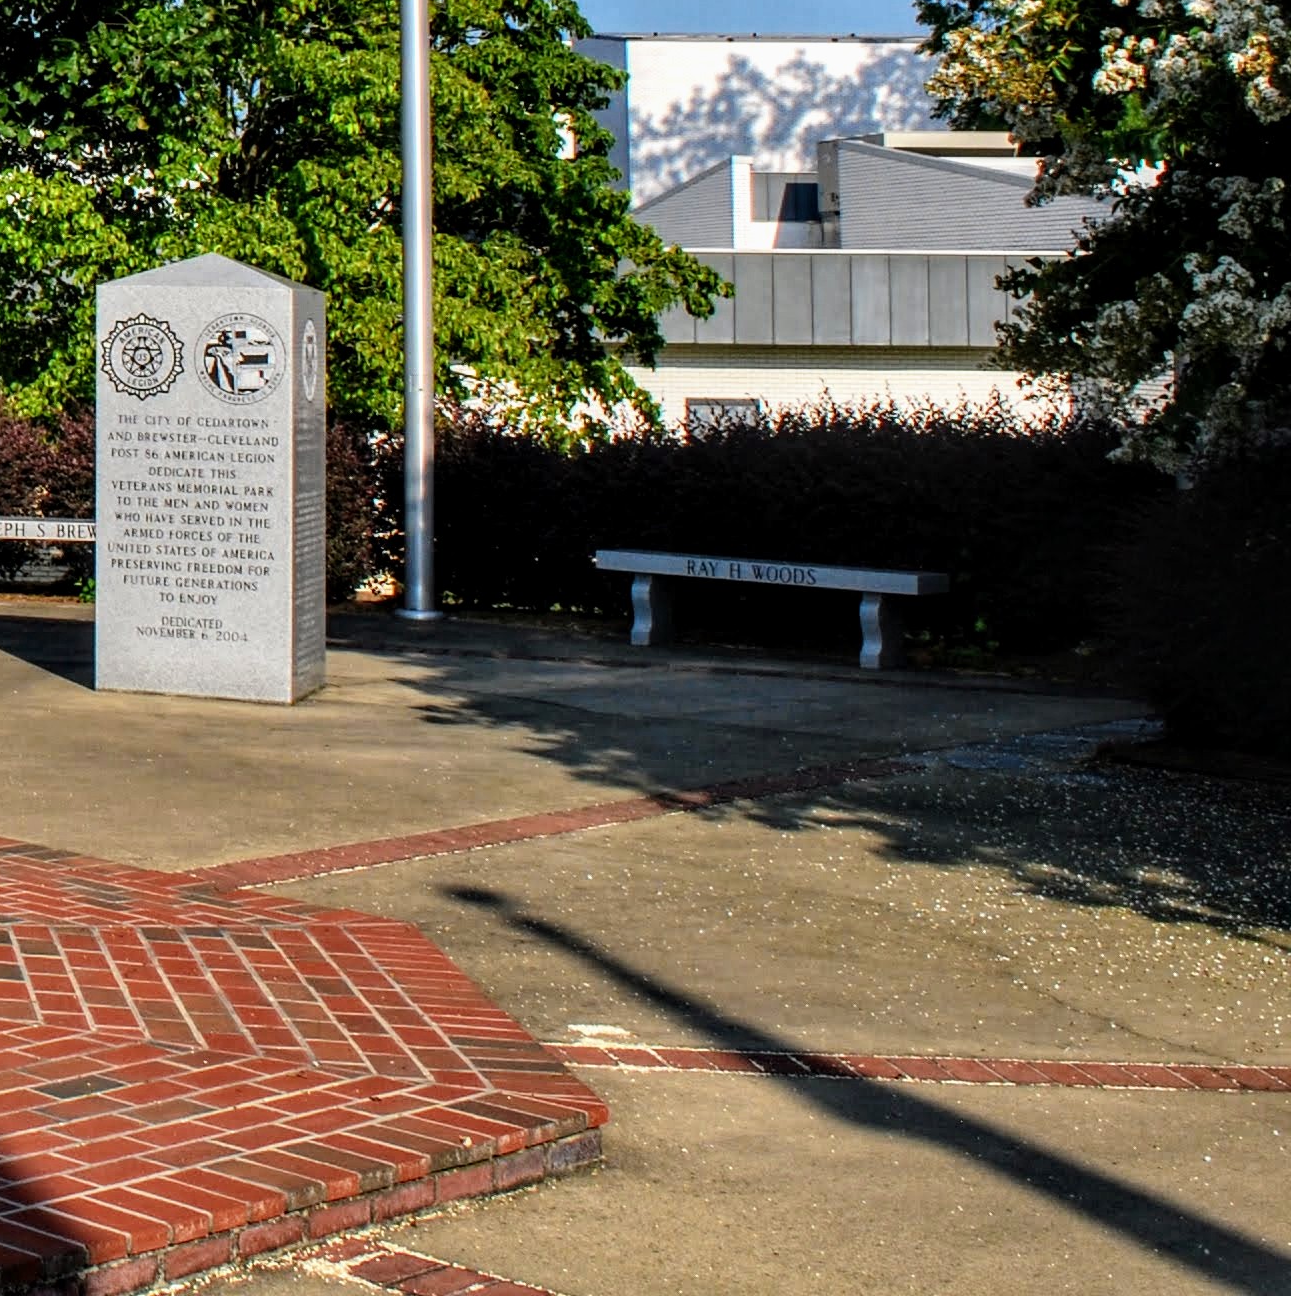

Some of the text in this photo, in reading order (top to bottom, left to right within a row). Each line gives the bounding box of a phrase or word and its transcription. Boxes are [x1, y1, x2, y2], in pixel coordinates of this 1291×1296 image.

[119, 327, 165, 343] AMERICAN
[127, 377, 159, 386] LEGION
[119, 415, 269, 429] THE CITY OF CEDARTOWN
[108, 432, 132, 441] AND
[111, 448, 138, 457] POST
[164, 451, 224, 461] AMERICAN
[231, 453, 275, 463] LEGION
[149, 467, 236, 479] DEDICATE THIS
[111, 481, 274, 496] VETERANS MEMORIAL PARK
[117, 497, 268, 512] TO THE MEN AND WOMEN
[115, 512, 270, 528] WHO HAVE SERVED IN THE
[37, 523, 45, 537] S
[124, 529, 260, 543] ARMED FORCES OF THE
[108, 543, 275, 560] UNITED STATES OF AMERICA
[111, 559, 270, 576] PRESERVING FREEDOM FOR
[687, 560, 817, 585] RAY H WOODS
[124, 575, 258, 591] FUTURE GENERATIONS
[160, 593, 217, 605] TO ENJOY
[161, 616, 222, 629] DEDICATED
[136, 627, 195, 639] NOVEMBER
[216, 633, 248, 642] 2004
